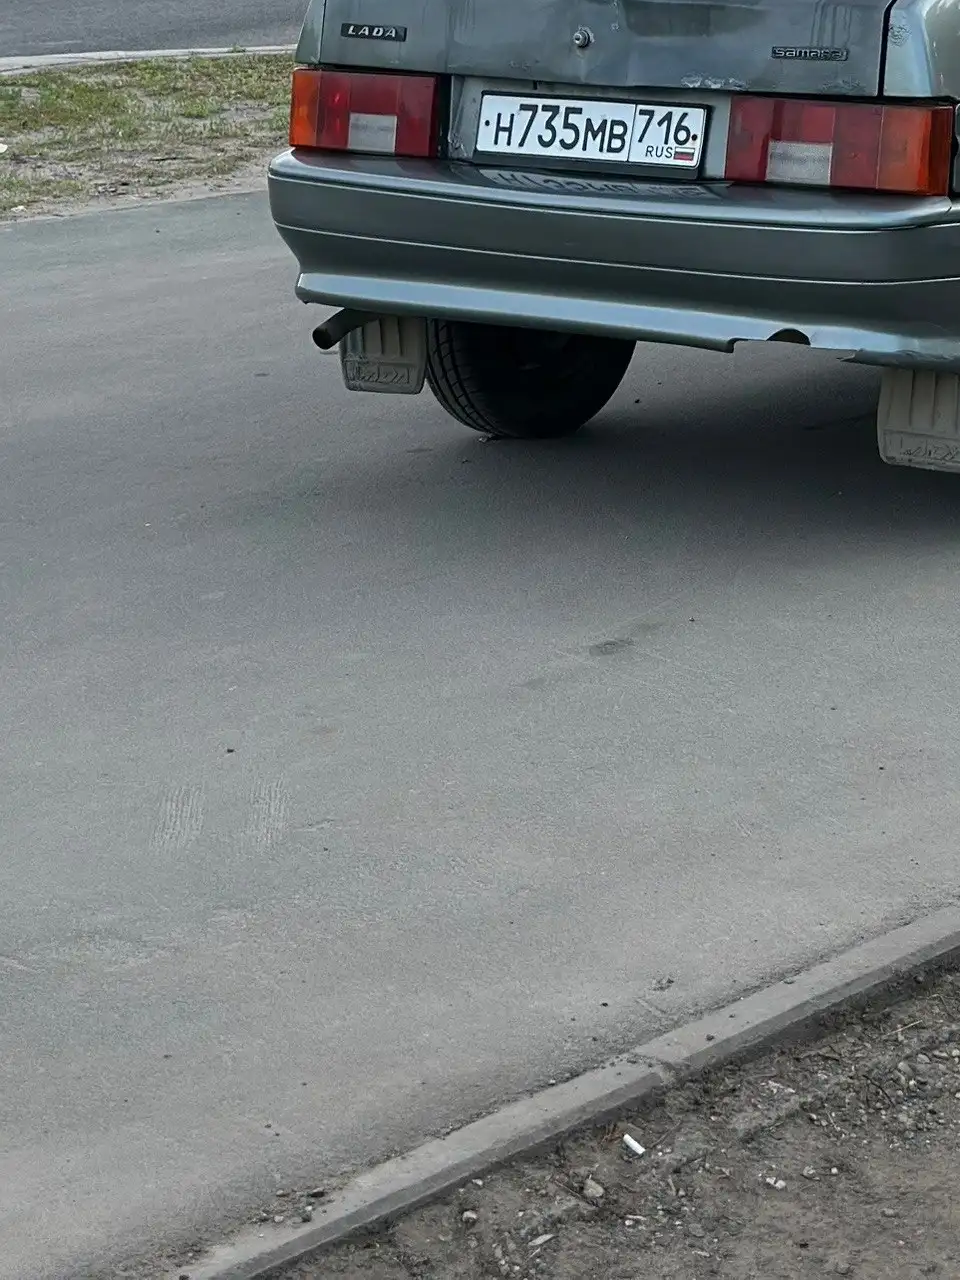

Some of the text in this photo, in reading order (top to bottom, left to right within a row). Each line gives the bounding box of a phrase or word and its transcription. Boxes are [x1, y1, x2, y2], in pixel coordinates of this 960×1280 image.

[347, 25, 396, 38] LADA
[637, 109, 691, 146] 716
[645, 146, 673, 159] RUS
